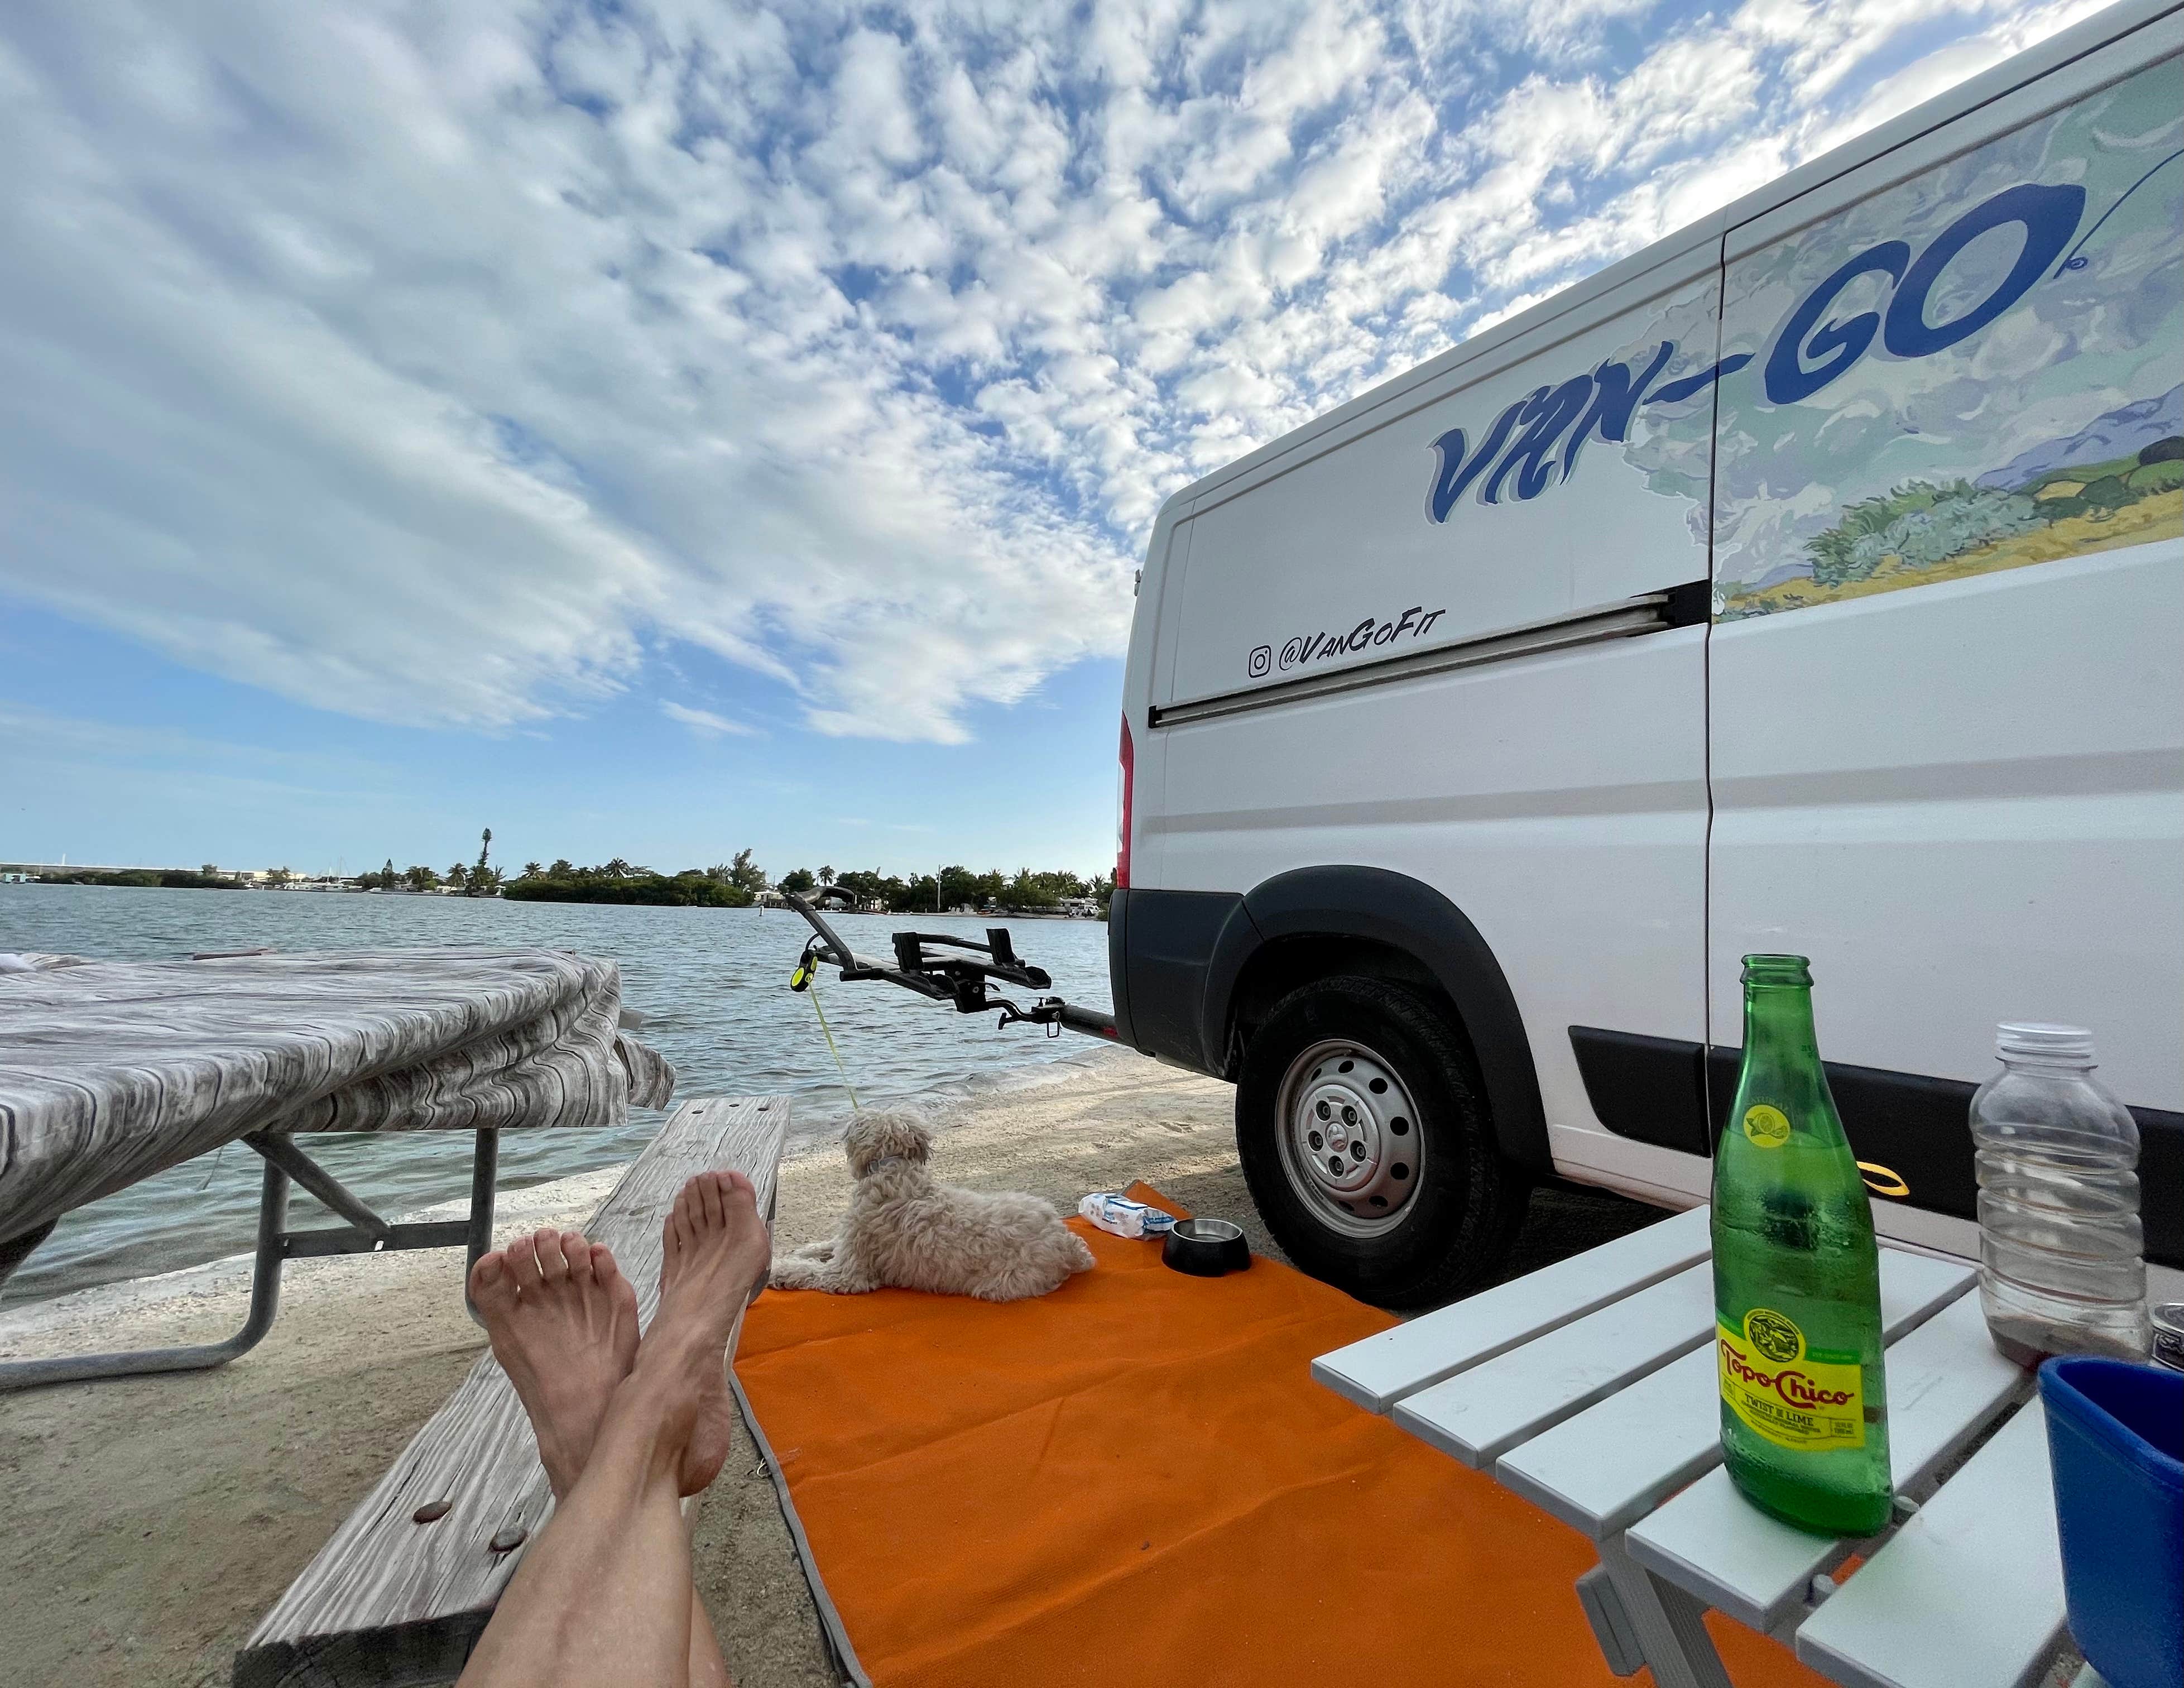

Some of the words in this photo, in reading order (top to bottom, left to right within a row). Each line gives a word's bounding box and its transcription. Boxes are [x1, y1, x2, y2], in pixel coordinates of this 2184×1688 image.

[1720, 1338, 1777, 1388] Topo
[1775, 1370, 1855, 1410] Chico
[1744, 1393, 1774, 1413] TWIST
[1786, 1411, 1813, 1427] LIME
